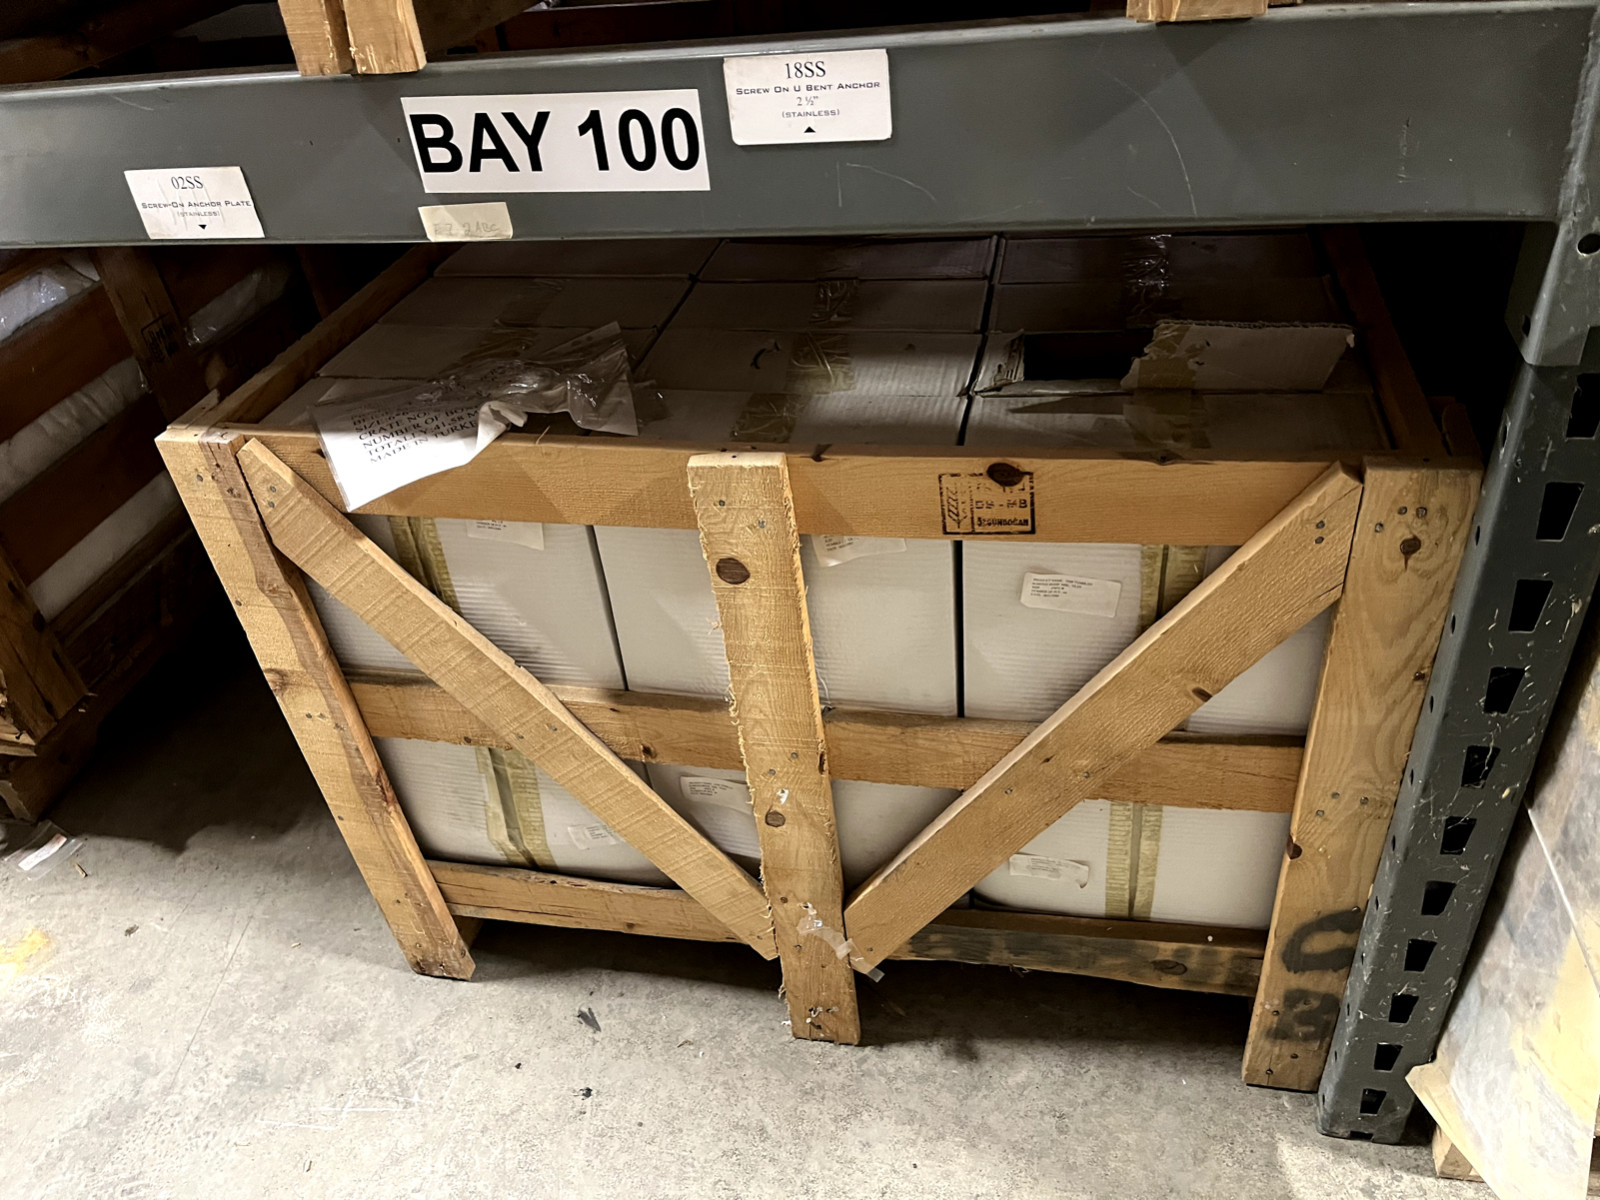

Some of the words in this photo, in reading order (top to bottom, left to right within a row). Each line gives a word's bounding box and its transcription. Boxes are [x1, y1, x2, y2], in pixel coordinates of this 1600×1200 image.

[784, 60, 827, 80] 18SS
[805, 84, 834, 92] BENT
[836, 81, 881, 90] ANCHOR
[796, 96, 803, 106] 2
[781, 108, 841, 118] (STAINLESS)
[409, 110, 551, 173] BAY
[577, 107, 701, 172] 100
[171, 175, 204, 190] 02SS
[188, 200, 222, 208] ANCHOR
